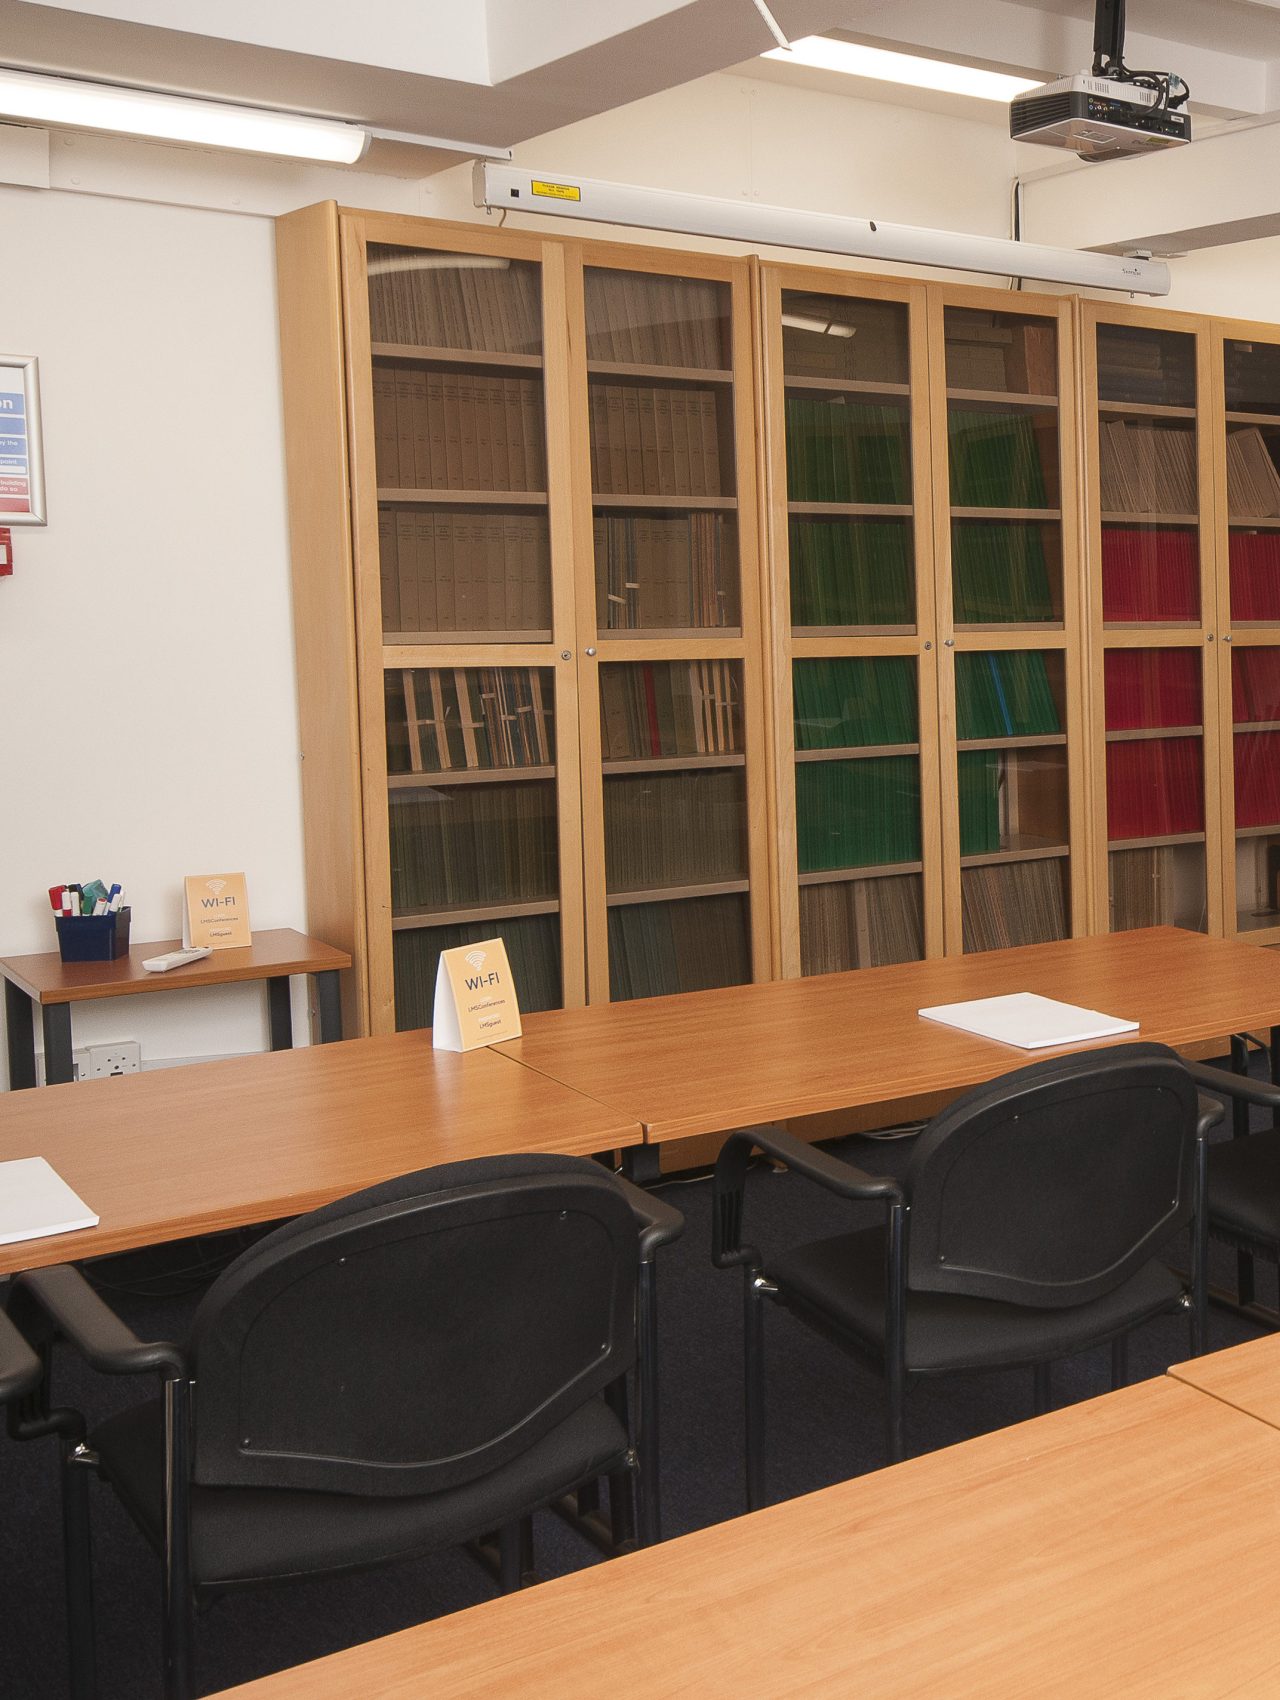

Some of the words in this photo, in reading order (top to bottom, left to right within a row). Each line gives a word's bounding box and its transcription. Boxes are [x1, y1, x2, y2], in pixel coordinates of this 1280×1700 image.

[201, 896, 236, 908] WI-FI
[465, 972, 500, 991] WI-FI
[468, 1000, 506, 1012] LMSConferences
[479, 1019, 502, 1029] LMSguest
